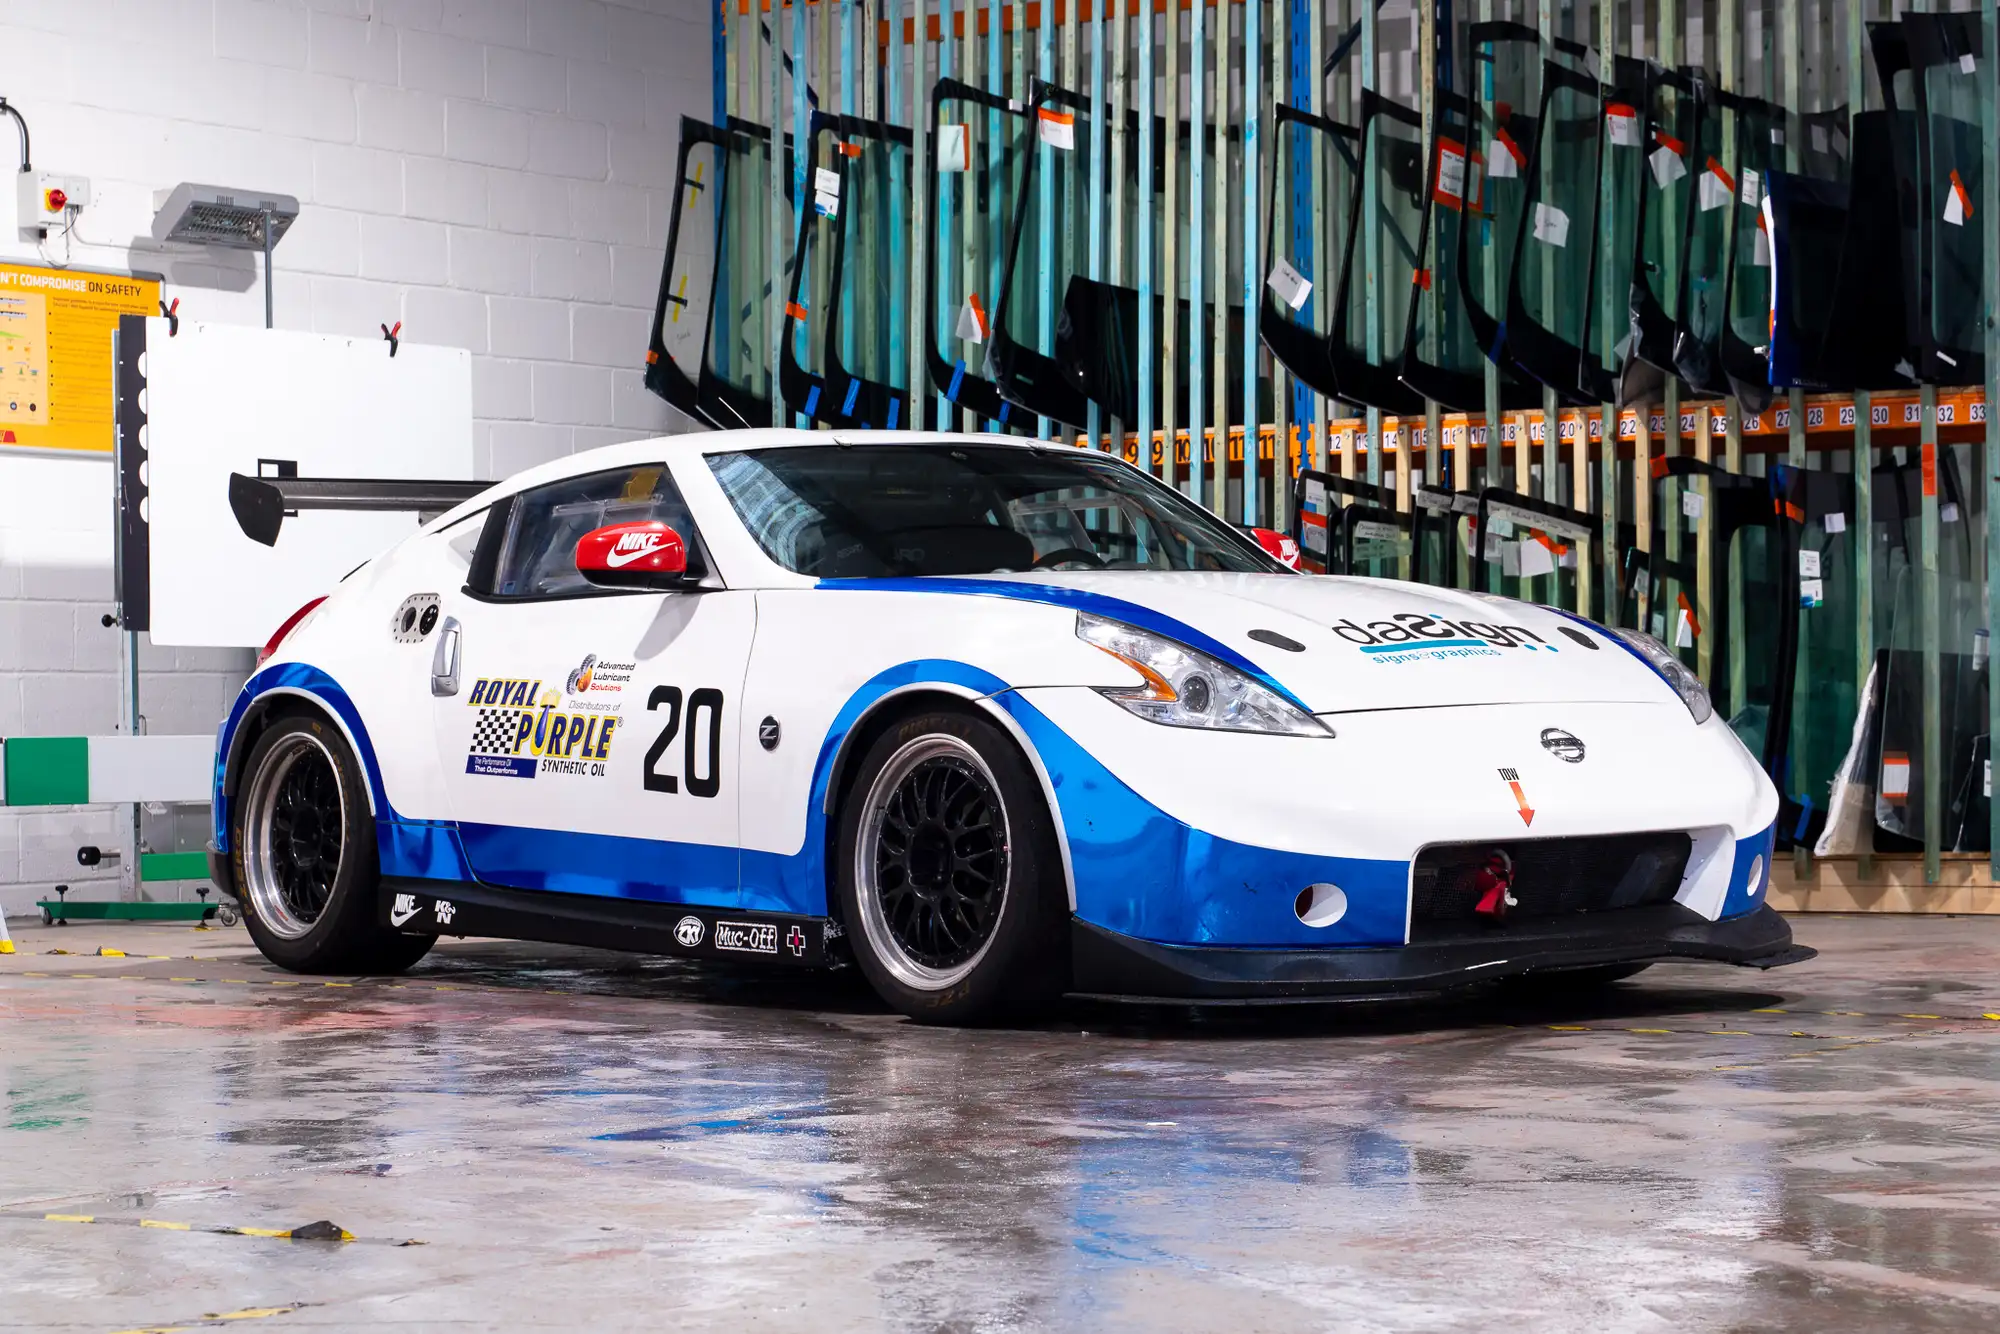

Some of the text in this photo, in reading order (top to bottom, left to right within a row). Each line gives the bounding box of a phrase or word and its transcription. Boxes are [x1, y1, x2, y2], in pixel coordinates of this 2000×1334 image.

[20, 274, 86, 292] COMPROMISE
[88, 281, 103, 293] ON
[105, 282, 142, 296] SAFETY
[1328, 435, 1341, 450] 12
[1384, 434, 1397, 448] 14
[1413, 429, 1427, 446] 15
[1470, 428, 1487, 443] 17
[1501, 425, 1516, 440] 18
[1560, 422, 1575, 437] 20
[1620, 419, 1636, 435] 22
[1651, 417, 1666, 432] 23
[1681, 415, 1695, 431] 24
[1712, 417, 1727, 432] 25
[1743, 416, 1759, 430] 26
[1776, 411, 1790, 427] 27
[1809, 410, 1823, 425] 28
[1841, 408, 1855, 423] 29
[1873, 407, 1888, 423] 30
[1905, 406, 1920, 421] 31
[1938, 406, 1953, 422] 32
[1971, 405, 1986, 421] 33
[616, 532, 663, 550] NIKE
[597, 661, 636, 671] Advanced
[593, 673, 631, 682] Lubricant
[467, 678, 542, 709] ROYAL
[590, 683, 622, 692] Solutions
[568, 700, 622, 711] Distributors of
[512, 711, 618, 760] PURPLE
[643, 684, 724, 798] 20
[474, 765, 519, 775] That Outperforms
[541, 759, 605, 777] SYNTHETIC OIL
[1496, 767, 1520, 781] TOW
[394, 893, 416, 913] NIKE
[717, 925, 776, 951] Muc-Off
